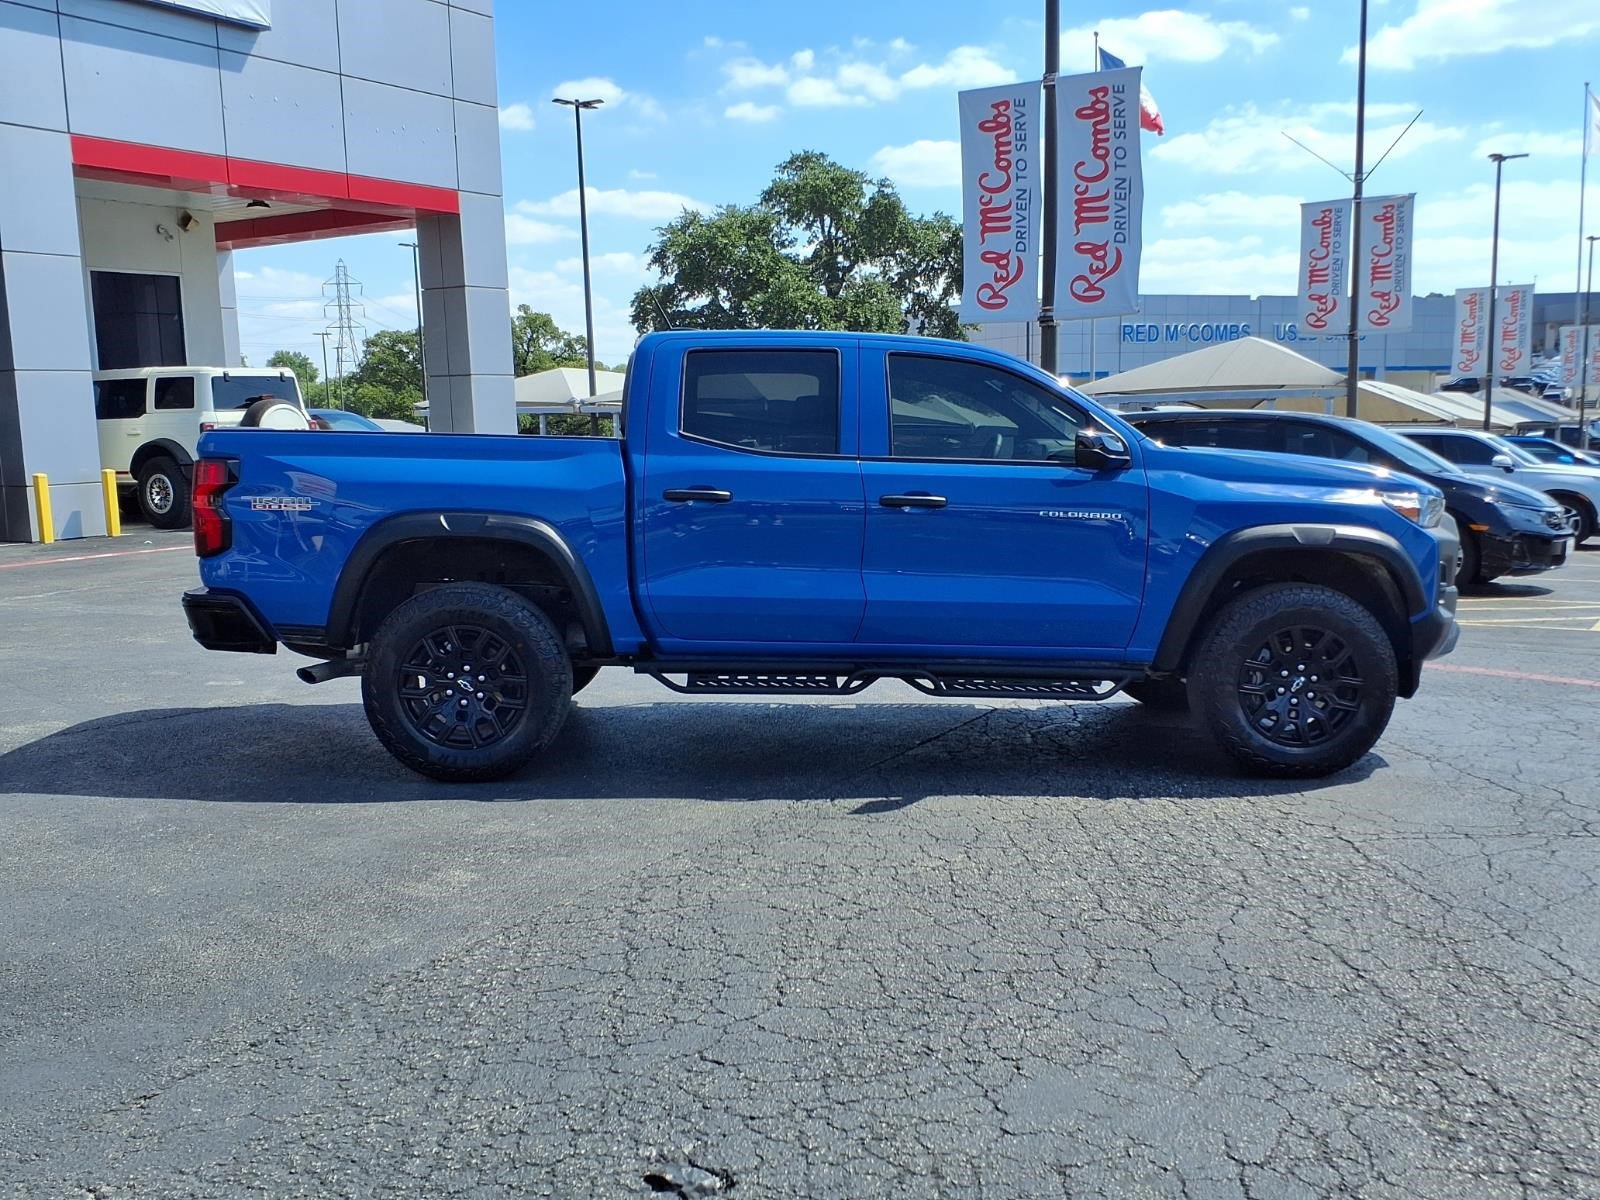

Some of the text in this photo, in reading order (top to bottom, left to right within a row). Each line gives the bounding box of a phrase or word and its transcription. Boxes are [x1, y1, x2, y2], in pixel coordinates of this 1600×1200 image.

[977, 100, 1024, 310] Red McCombs
[1014, 98, 1028, 253] DRIVEN TO SERVE
[1070, 85, 1122, 303] Red McCombs
[1113, 84, 1127, 244] DRIVEN TO SERVE
[1306, 208, 1337, 329] Red McCombs
[1331, 208, 1342, 295] DRIVEN TO SERVE
[1367, 204, 1400, 326] Red McCombs
[1394, 202, 1405, 292] DRIVEN TO SERVE
[1122, 323, 1160, 342] RED
[1458, 348, 1480, 372] Red
[1500, 347, 1522, 371] Red
[241, 496, 320, 505] TRAIL
[252, 503, 311, 511] BOSS
[1039, 510, 1122, 519] COLORADO
